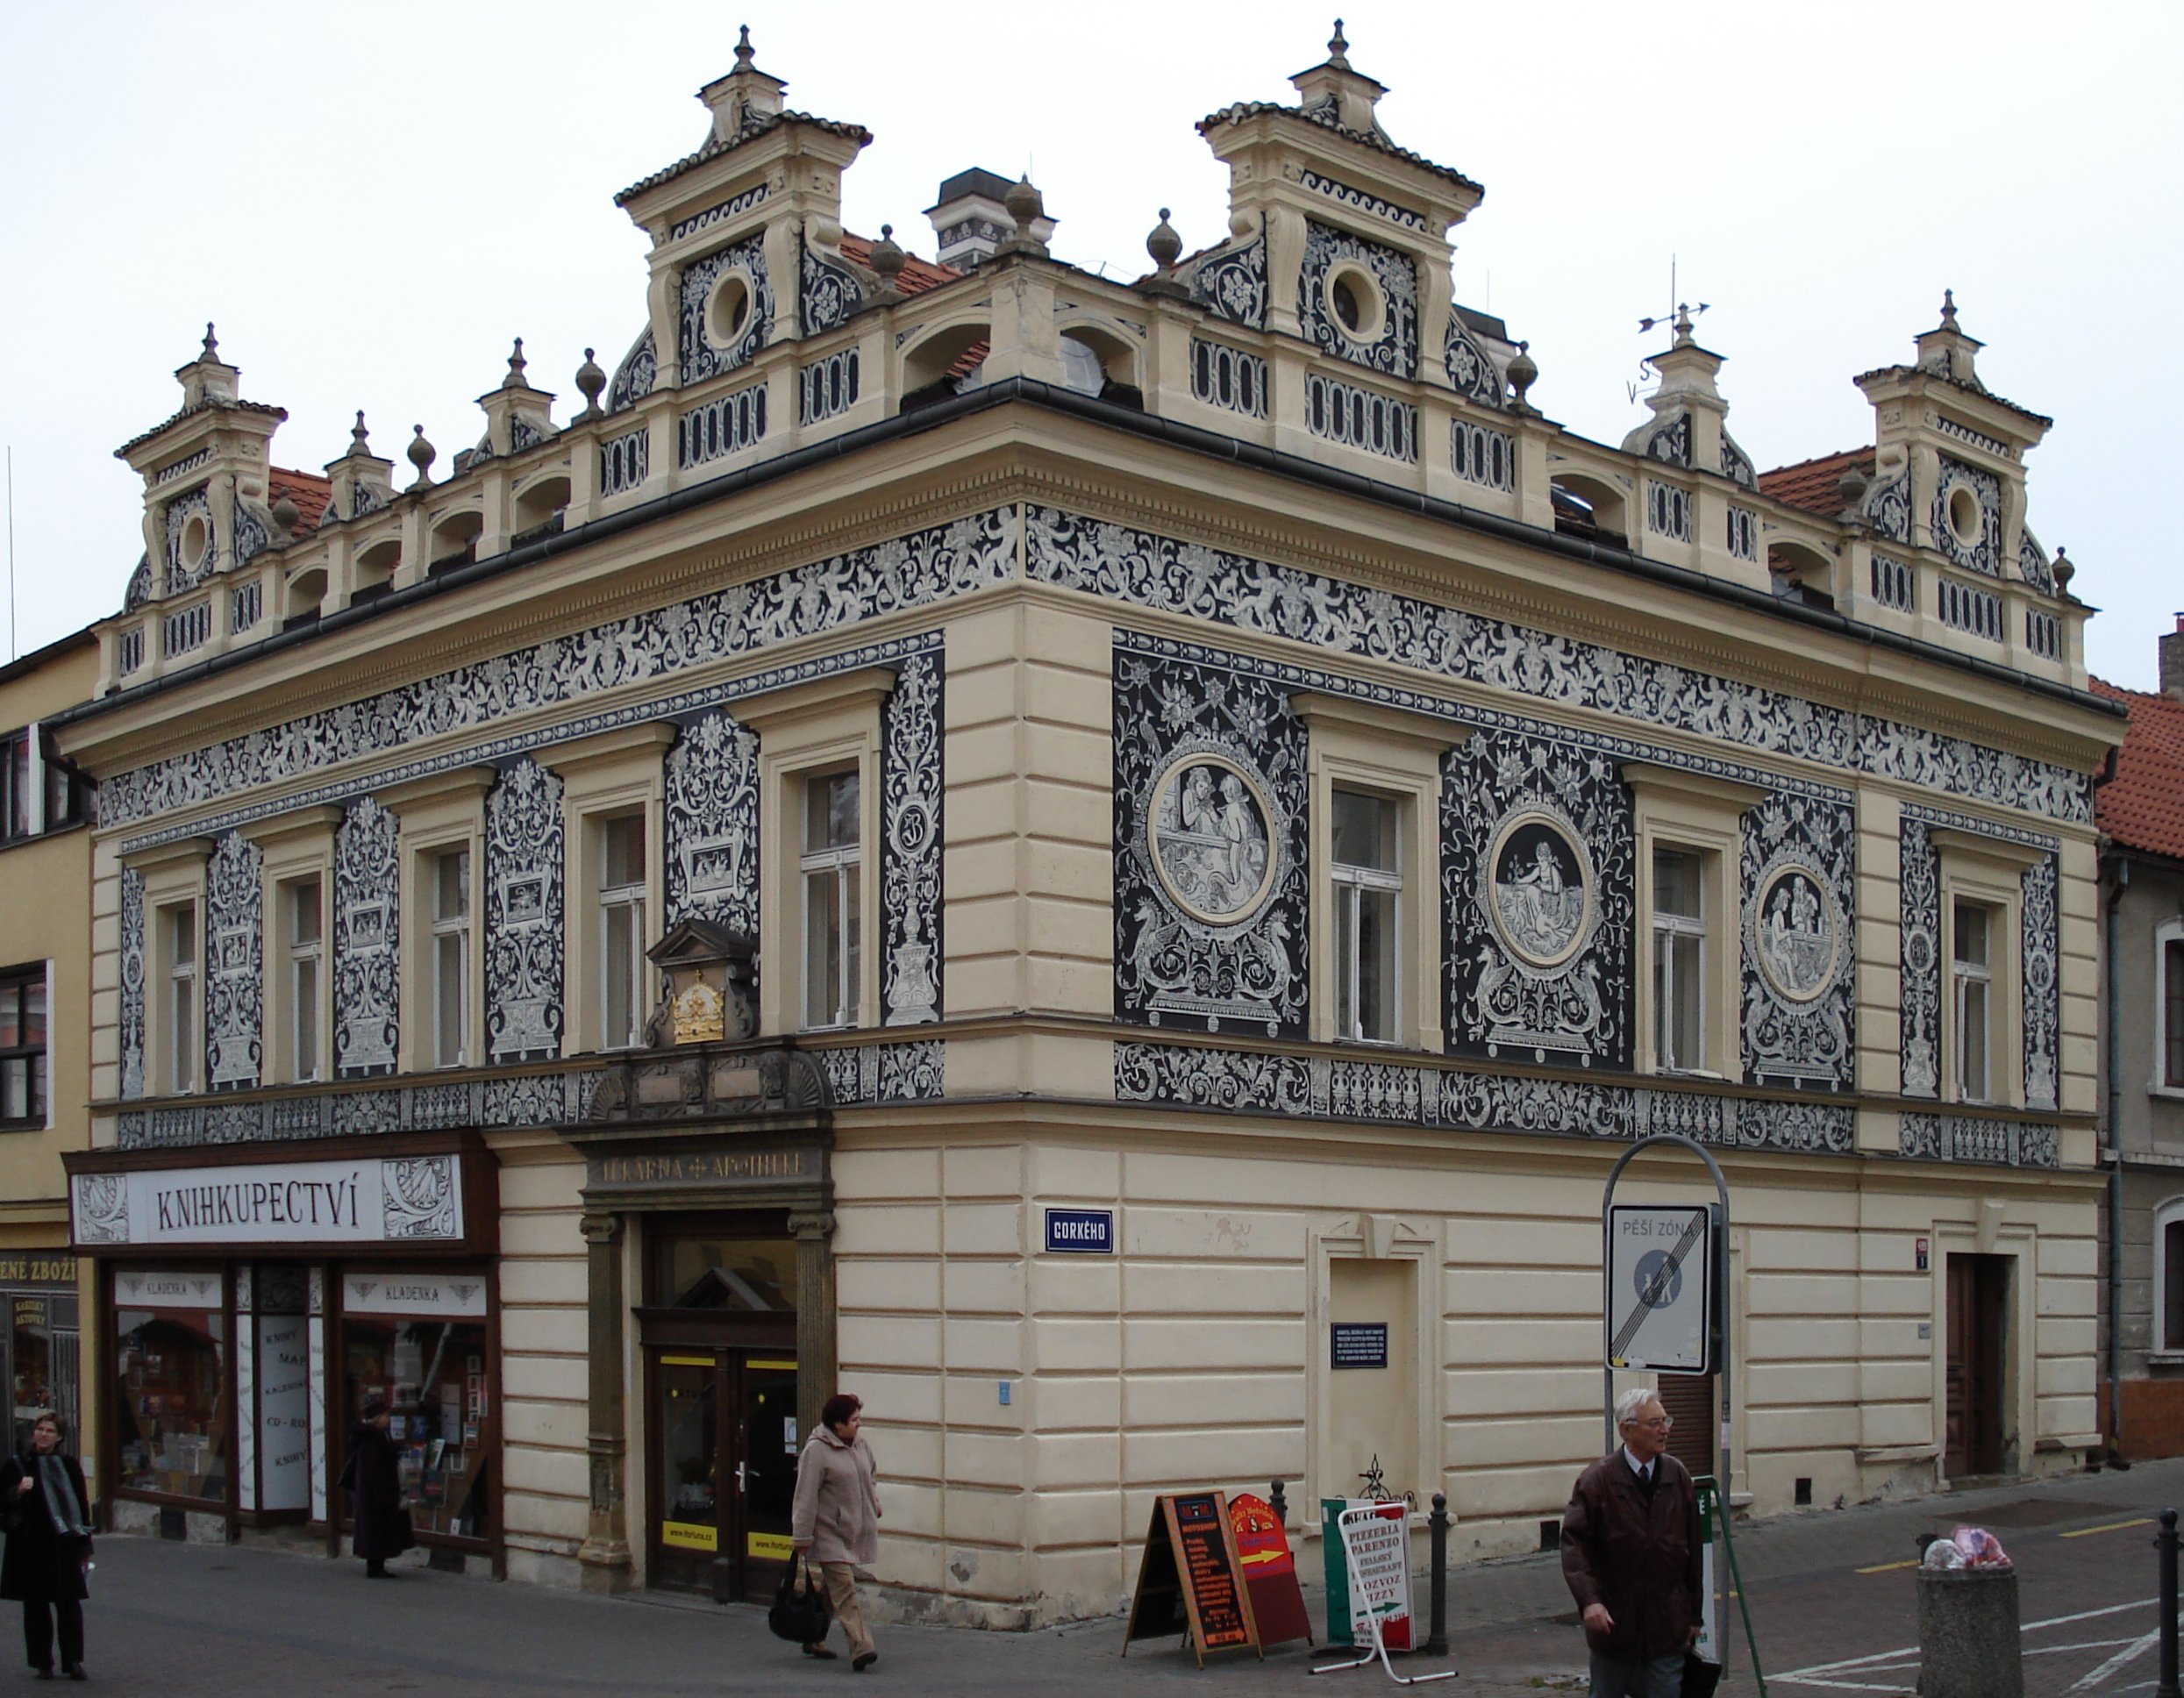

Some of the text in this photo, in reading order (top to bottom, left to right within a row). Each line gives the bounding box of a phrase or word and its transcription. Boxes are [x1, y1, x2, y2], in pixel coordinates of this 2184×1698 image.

[157, 1172, 360, 1230] KNIHKUPECTVÍ
[1054, 1220, 1105, 1240] GORKÉHO
[1623, 1218, 1653, 1236] PĚŠÍ
[31, 1256, 76, 1281] ZBOŽÍ
[386, 1286, 439, 1302] KLADENKA
[1349, 1523, 1400, 1544] PIZZERIA
[1352, 1537, 1400, 1557] PARENZO
[1367, 1587, 1395, 1603] IZZY
